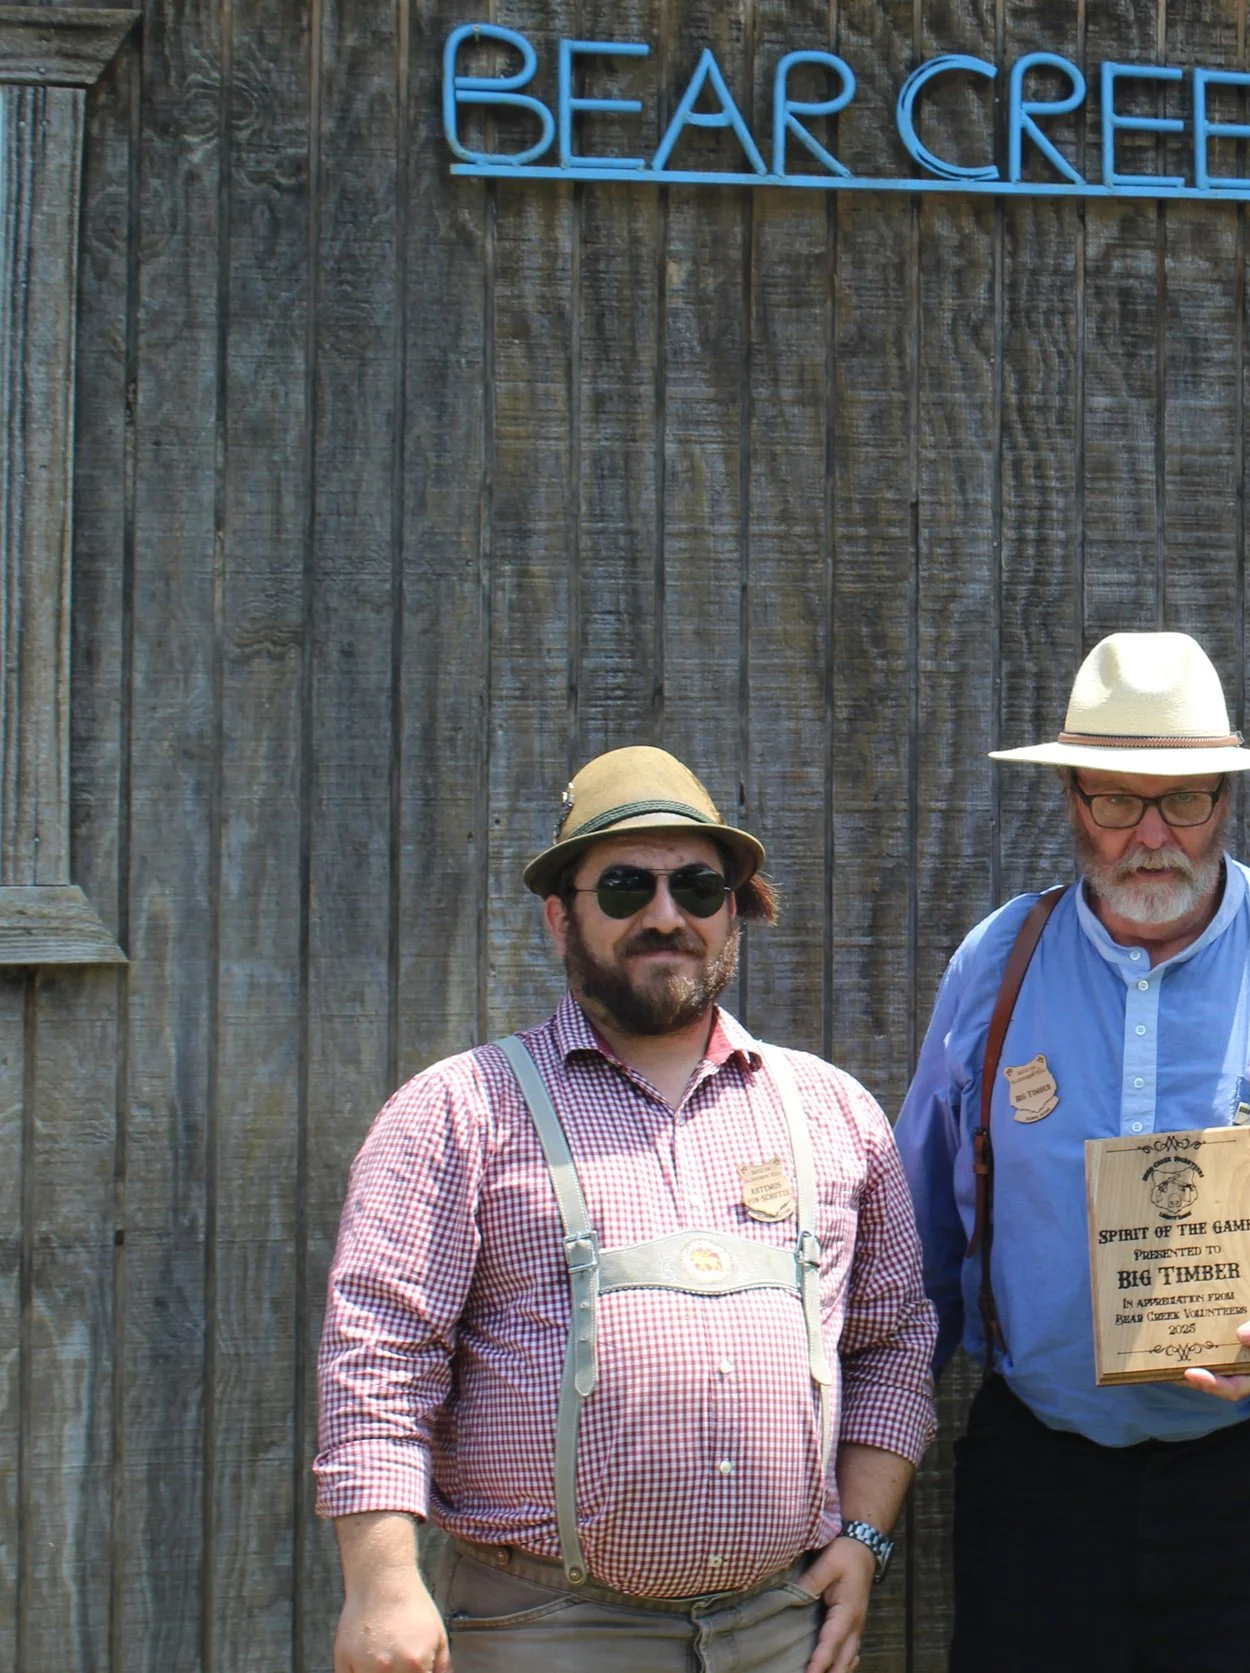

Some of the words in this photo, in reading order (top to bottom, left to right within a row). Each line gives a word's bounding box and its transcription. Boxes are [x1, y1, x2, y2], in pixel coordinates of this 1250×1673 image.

[443, 23, 854, 178] BEAR
[1098, 1227, 1149, 1244] SPIRIT
[1154, 1226, 1172, 1238] OF
[1177, 1222, 1207, 1236] THE
[1133, 1247, 1202, 1261] PRESENTED
[1205, 1245, 1222, 1254] TO
[1117, 1269, 1152, 1289] BIG
[1158, 1262, 1241, 1285] TIMBER
[1208, 1292, 1235, 1302] FROM
[1115, 1313, 1143, 1325] BEAR
[1146, 1310, 1180, 1322] CREEK
[1183, 1306, 1248, 1319] VOLUNTEERS
[1168, 1323, 1196, 1335] 2025
